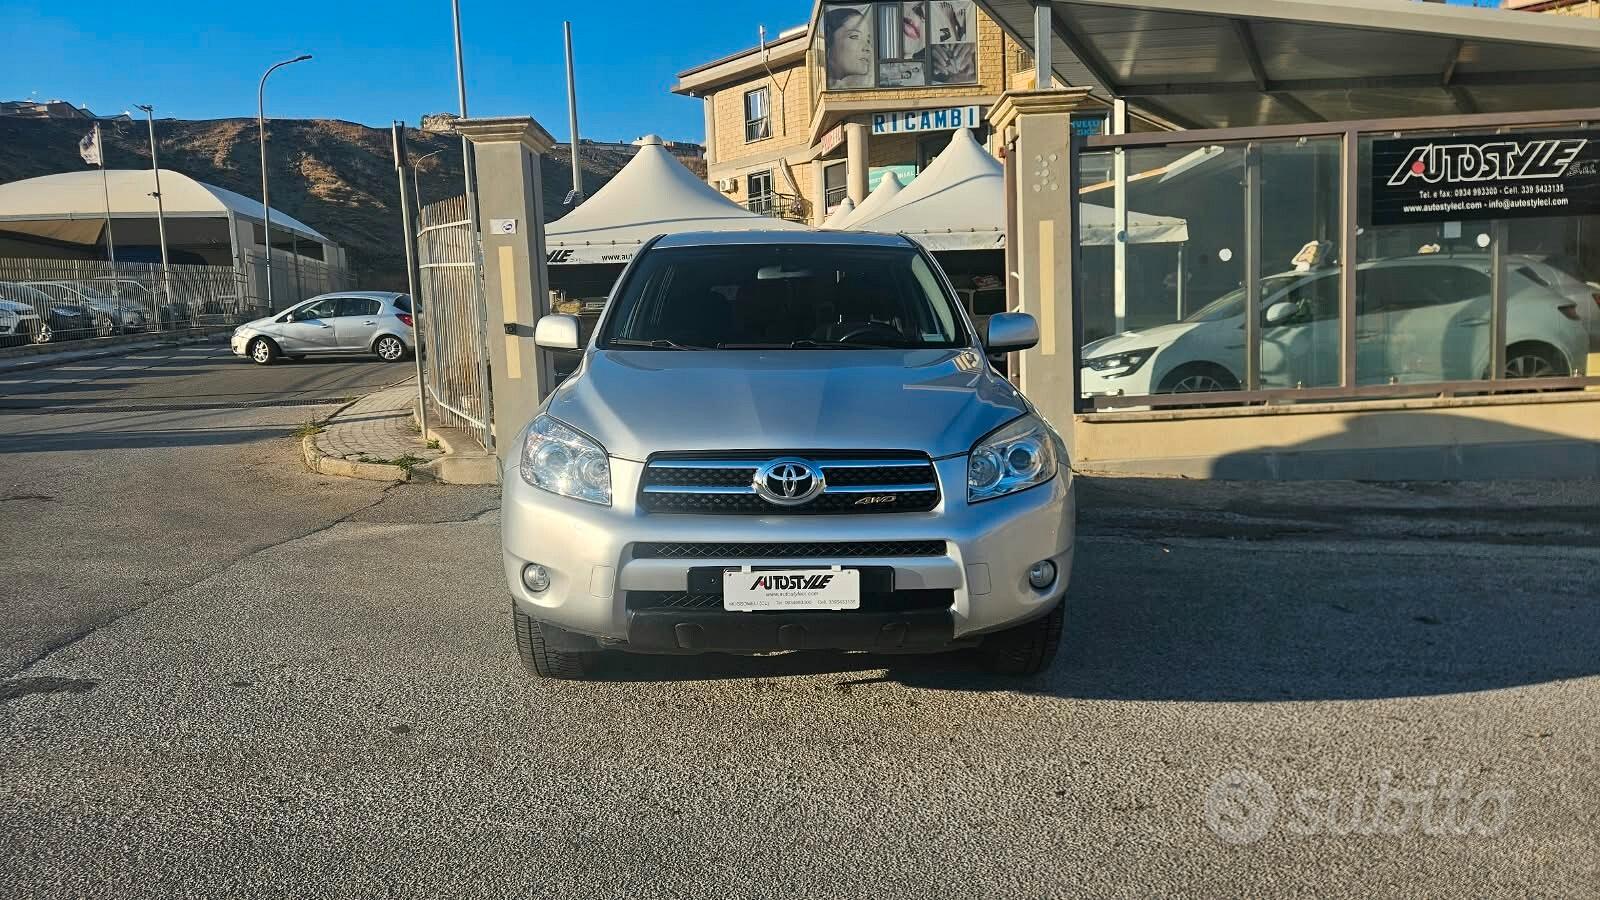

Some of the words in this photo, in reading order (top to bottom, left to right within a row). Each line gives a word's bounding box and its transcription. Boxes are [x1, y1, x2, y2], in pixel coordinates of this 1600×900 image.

[874, 107, 974, 133] RICAMBI
[1387, 139, 1587, 185] AUTOSTYLE
[1419, 190, 1431, 199] Tel.
[1503, 185, 1520, 195] Cell.
[1521, 185, 1533, 194] 339
[750, 574, 834, 590] AUTOSTYLE
